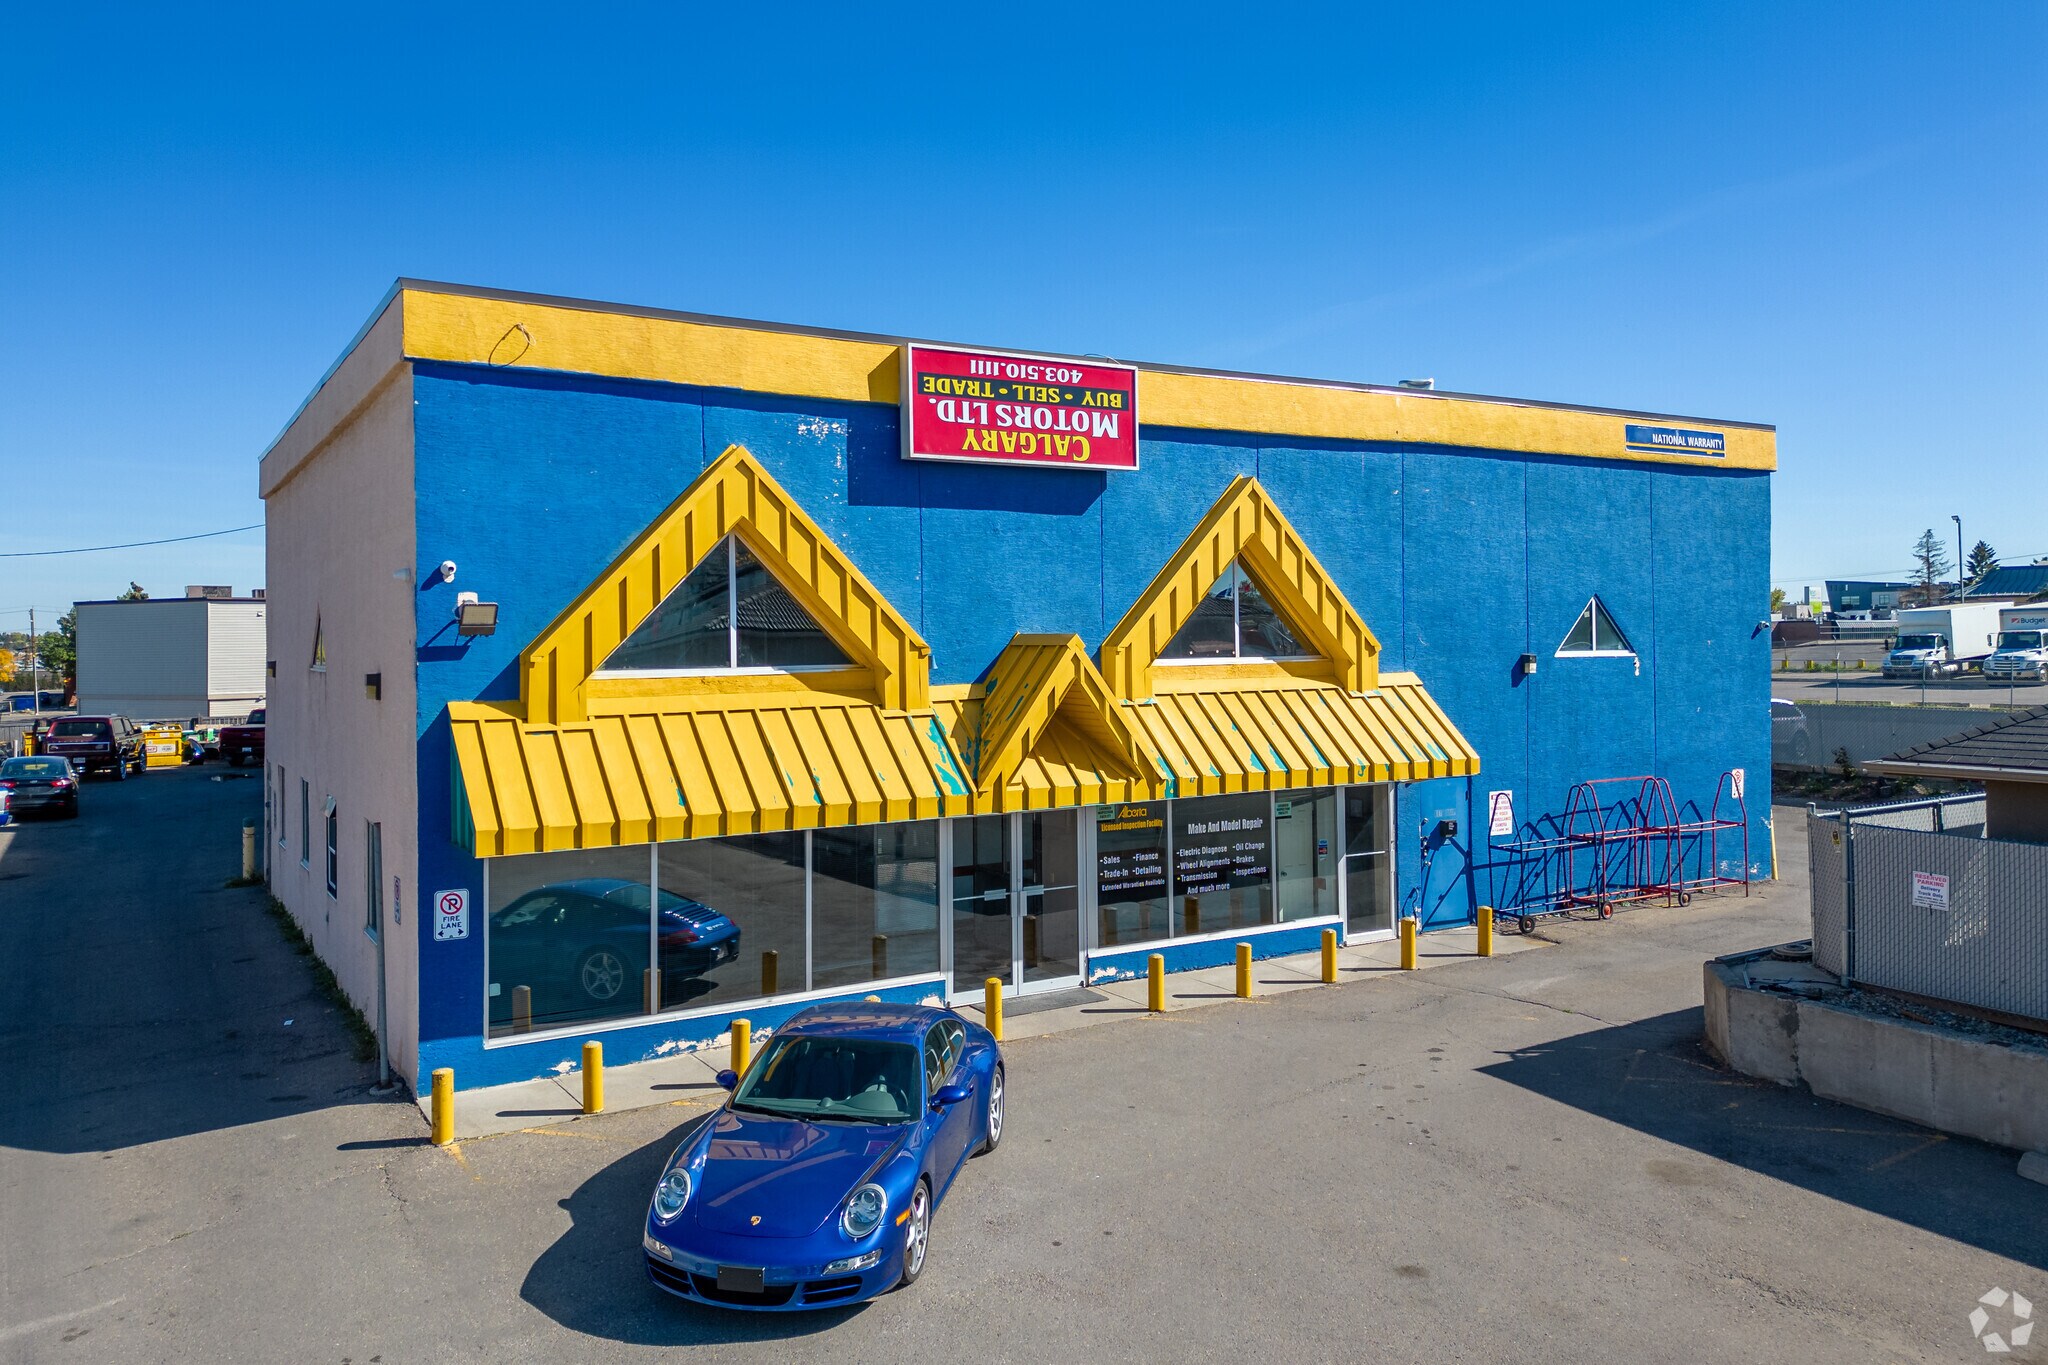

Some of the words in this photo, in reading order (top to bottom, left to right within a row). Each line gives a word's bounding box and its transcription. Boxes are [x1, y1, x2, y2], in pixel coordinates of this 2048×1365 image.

[970, 359, 1083, 384] 403.510.1111
[923, 376, 995, 398] TRADE
[1012, 384, 1061, 403] SELL
[1082, 391, 1123, 408] BUY
[928, 398, 988, 426] LTD.
[996, 404, 1120, 439] MOTORS
[961, 428, 1091, 462] CALGARY
[1652, 434, 1686, 446] NATIONAL
[1687, 436, 1723, 449] WARRANTY
[2020, 617, 2046, 625] Budget
[1188, 823, 1207, 835] Make
[1207, 821, 1220, 833] And
[1221, 819, 1241, 832] Model
[1242, 817, 1263, 830] Repair
[1201, 845, 1228, 855] Diagnose
[1244, 842, 1265, 851] Change
[1915, 873, 1946, 882] RESERVED
[1917, 879, 1944, 887] PARKING
[1187, 886, 1199, 895] And
[1199, 883, 1215, 893] much
[1215, 882, 1231, 892] more
